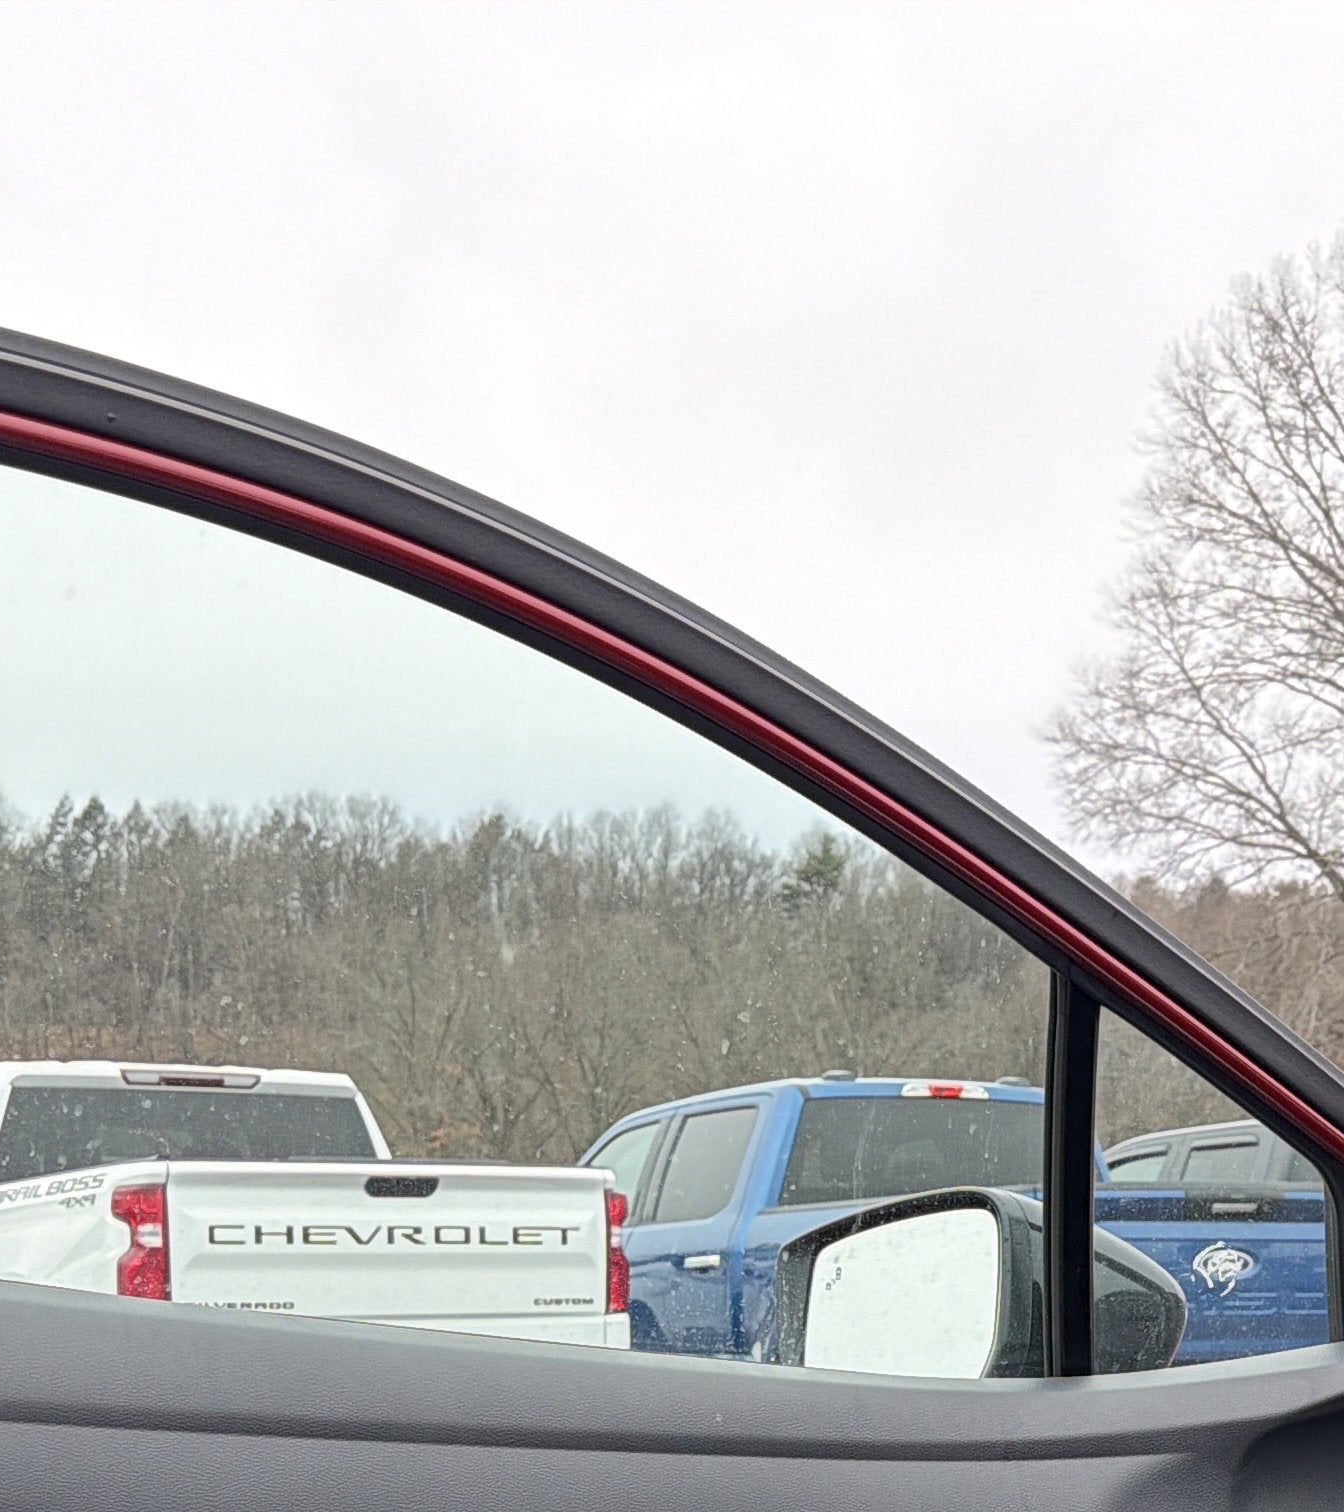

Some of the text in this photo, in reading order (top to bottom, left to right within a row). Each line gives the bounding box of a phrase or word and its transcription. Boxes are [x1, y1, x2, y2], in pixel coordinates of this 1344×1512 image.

[45, 1173, 107, 1196] BOSS
[208, 1225, 581, 1246] CHEVROLET
[533, 1297, 595, 1306] CUSTOM
